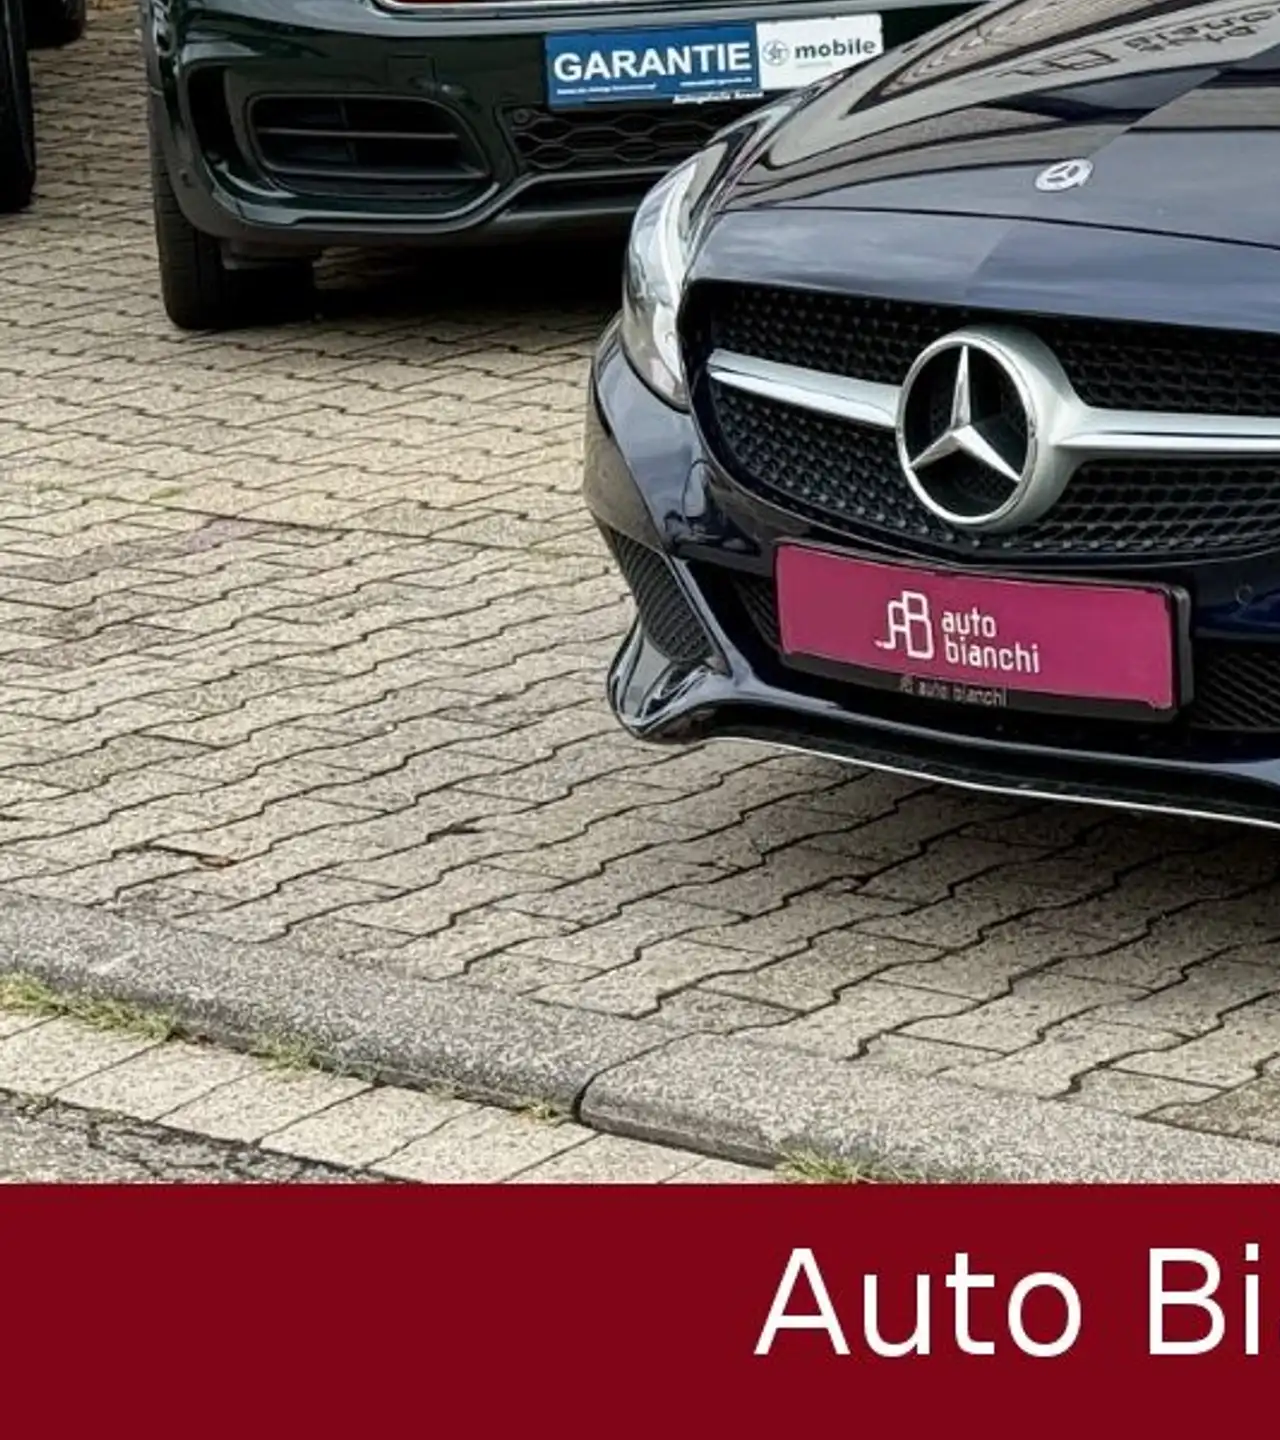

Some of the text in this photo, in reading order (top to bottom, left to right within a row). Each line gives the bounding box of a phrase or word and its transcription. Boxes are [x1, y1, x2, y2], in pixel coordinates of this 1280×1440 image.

[554, 43, 752, 81] GARANTIE
[795, 38, 876, 60] mobile
[941, 607, 996, 637] auto
[944, 633, 1040, 674] bianchi
